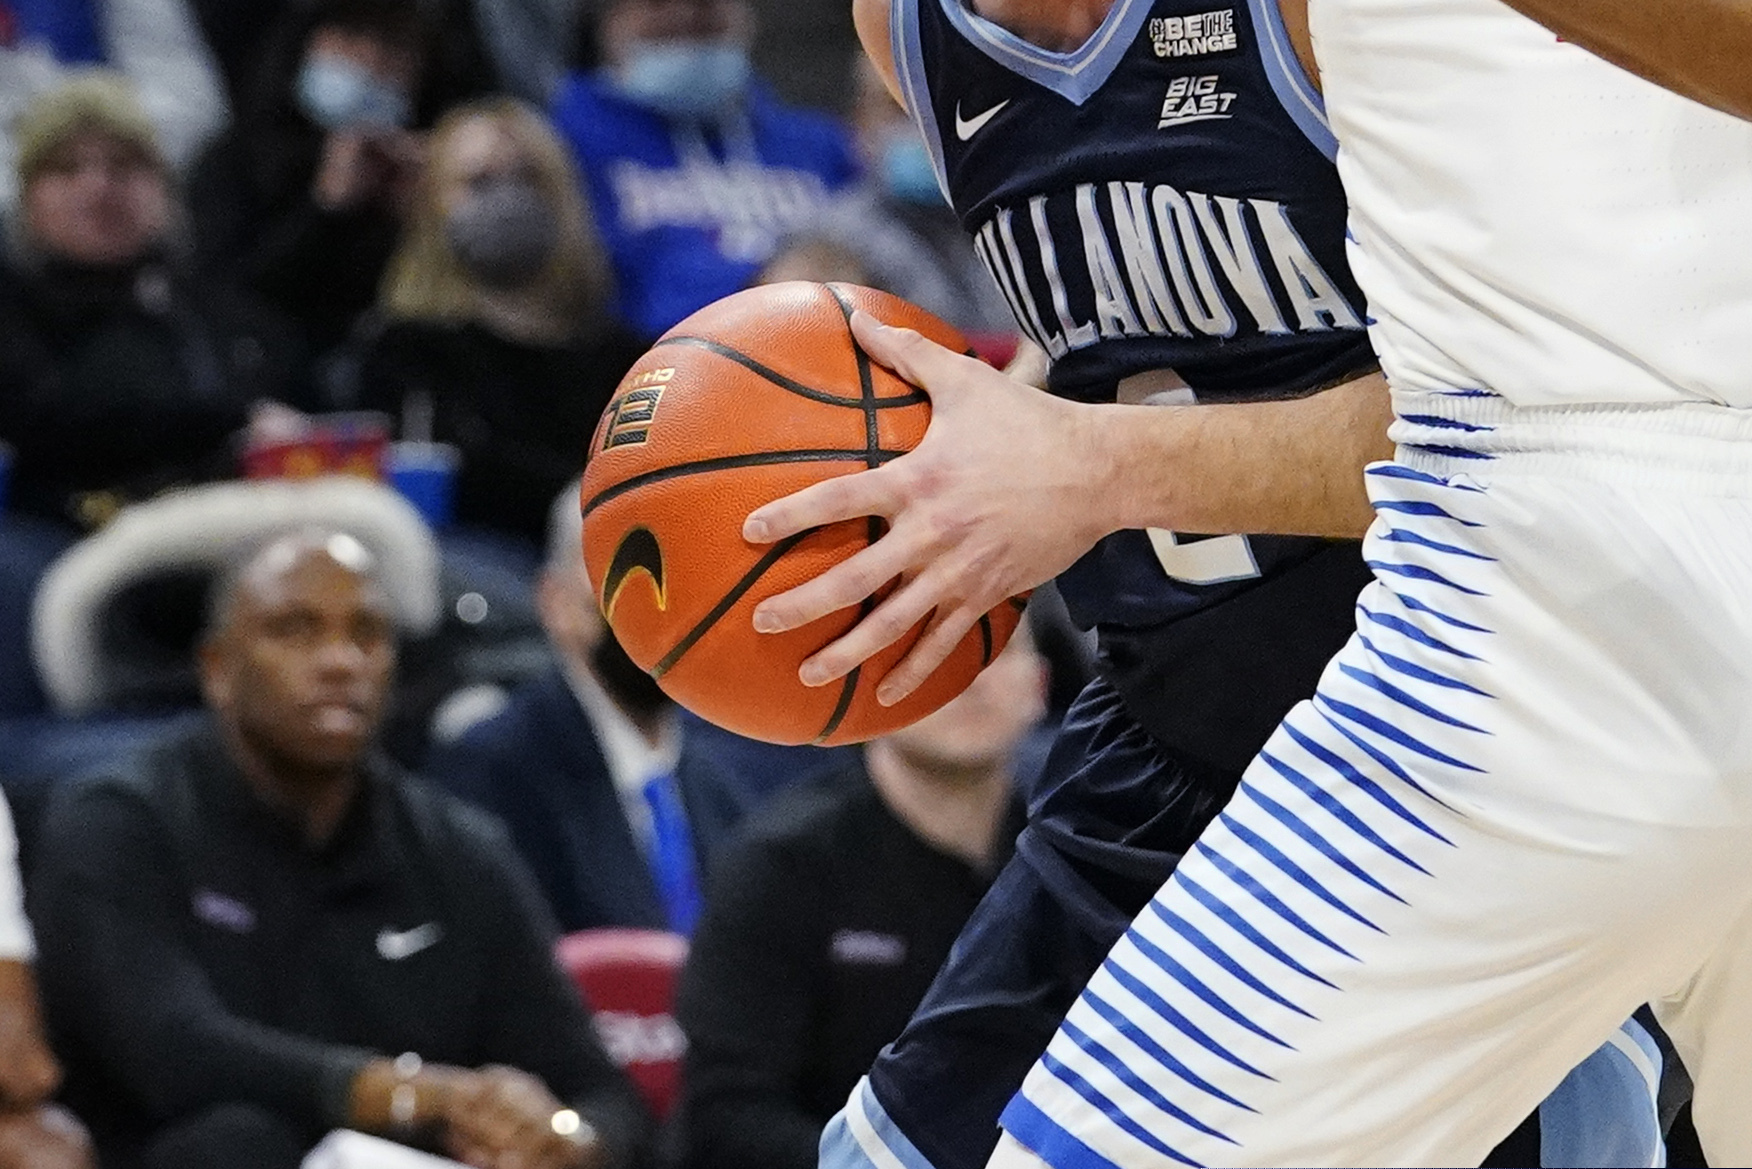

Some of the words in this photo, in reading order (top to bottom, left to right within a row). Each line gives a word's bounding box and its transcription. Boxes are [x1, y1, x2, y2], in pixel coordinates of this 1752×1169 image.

[1153, 33, 1238, 57] CHANGE
[1165, 75, 1219, 98] BIG
[1160, 93, 1238, 119] EAST
